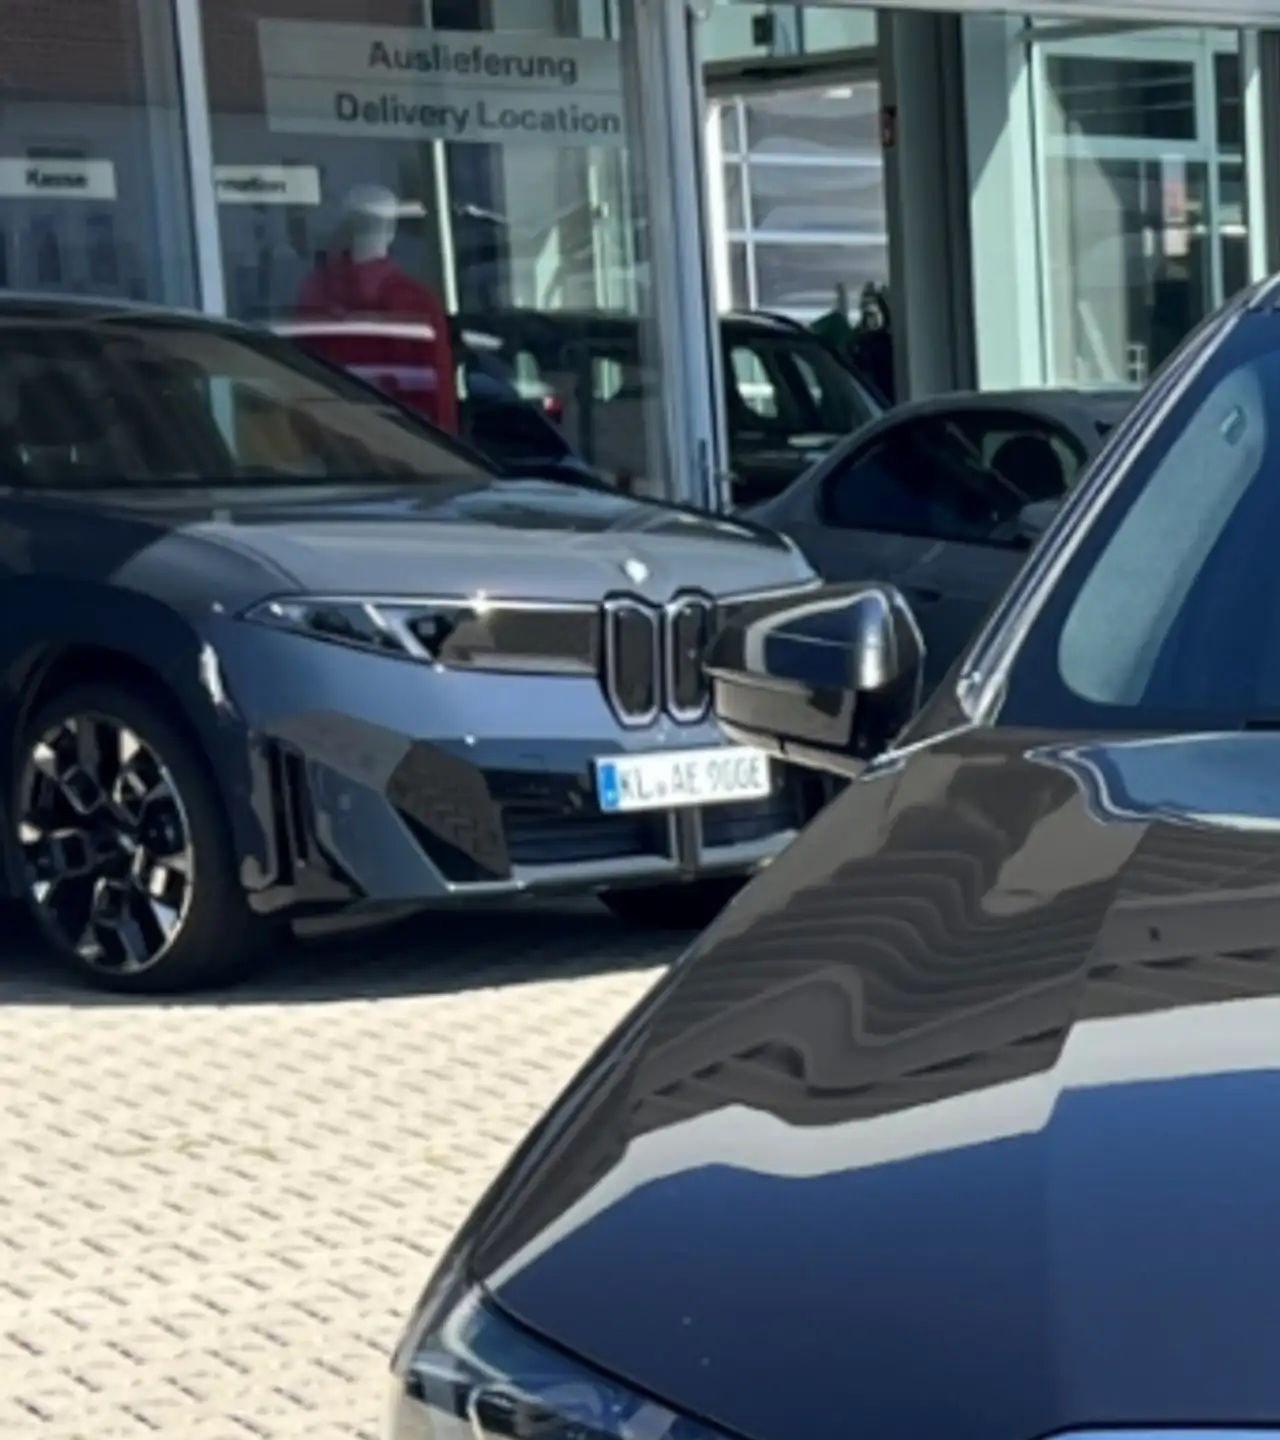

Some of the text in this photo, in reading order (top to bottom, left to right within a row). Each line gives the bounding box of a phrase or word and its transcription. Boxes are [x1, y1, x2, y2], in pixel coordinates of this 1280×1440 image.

[367, 41, 577, 85] Auslieferung
[335, 91, 620, 133] Delivery Location
